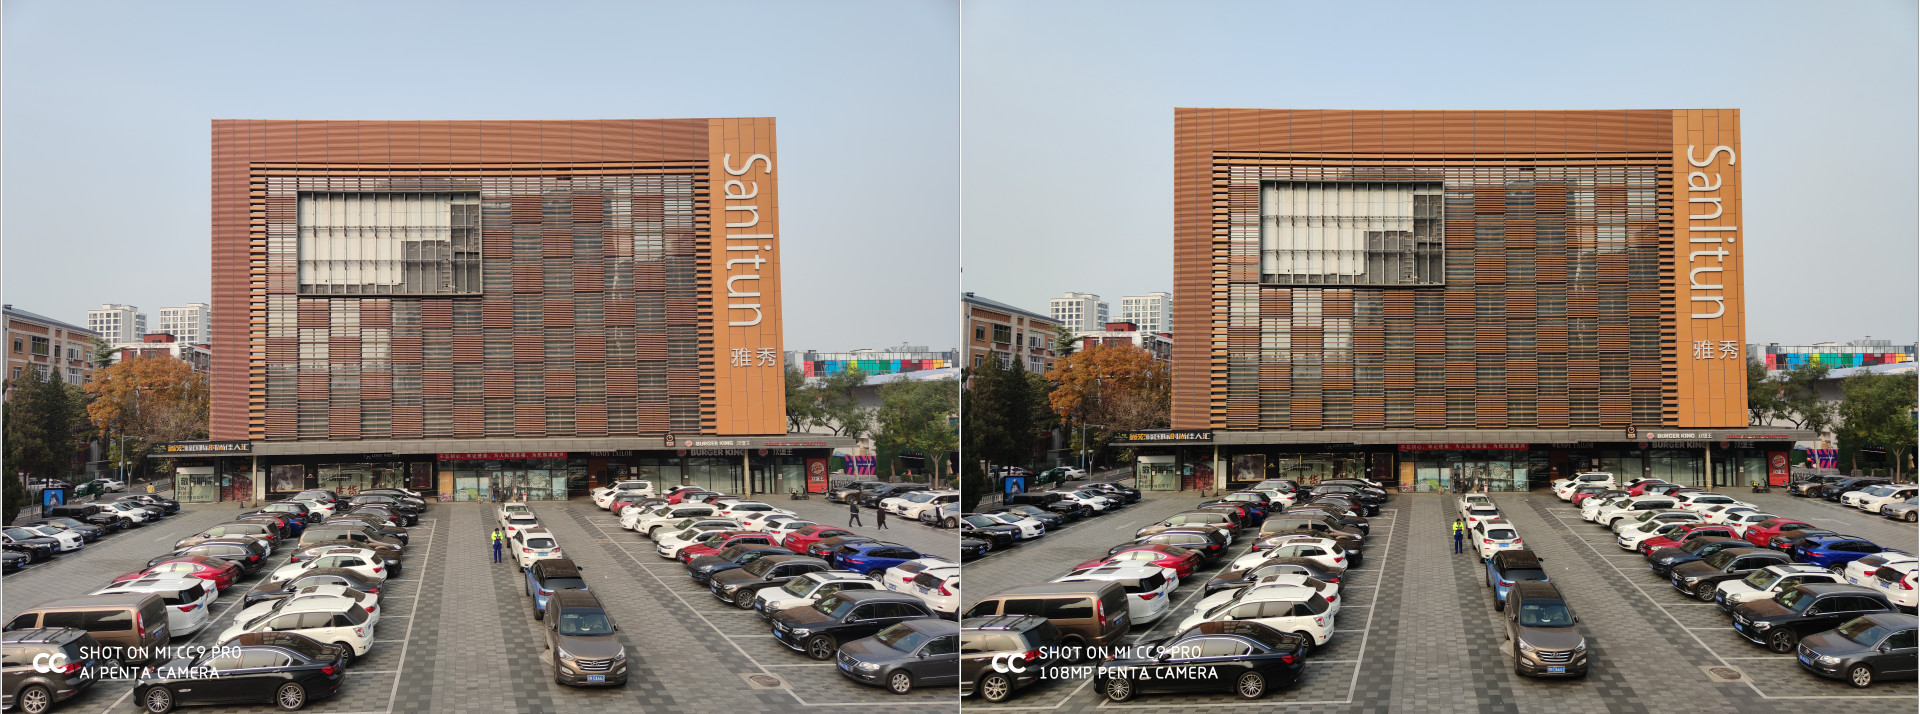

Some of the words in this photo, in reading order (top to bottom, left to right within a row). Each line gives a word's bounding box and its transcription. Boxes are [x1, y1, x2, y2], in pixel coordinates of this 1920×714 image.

[723, 153, 774, 327] Sanlitun
[1687, 144, 1738, 319] Sanlitun
[731, 347, 777, 367] 雅秀
[1693, 340, 1739, 360] 雅秀
